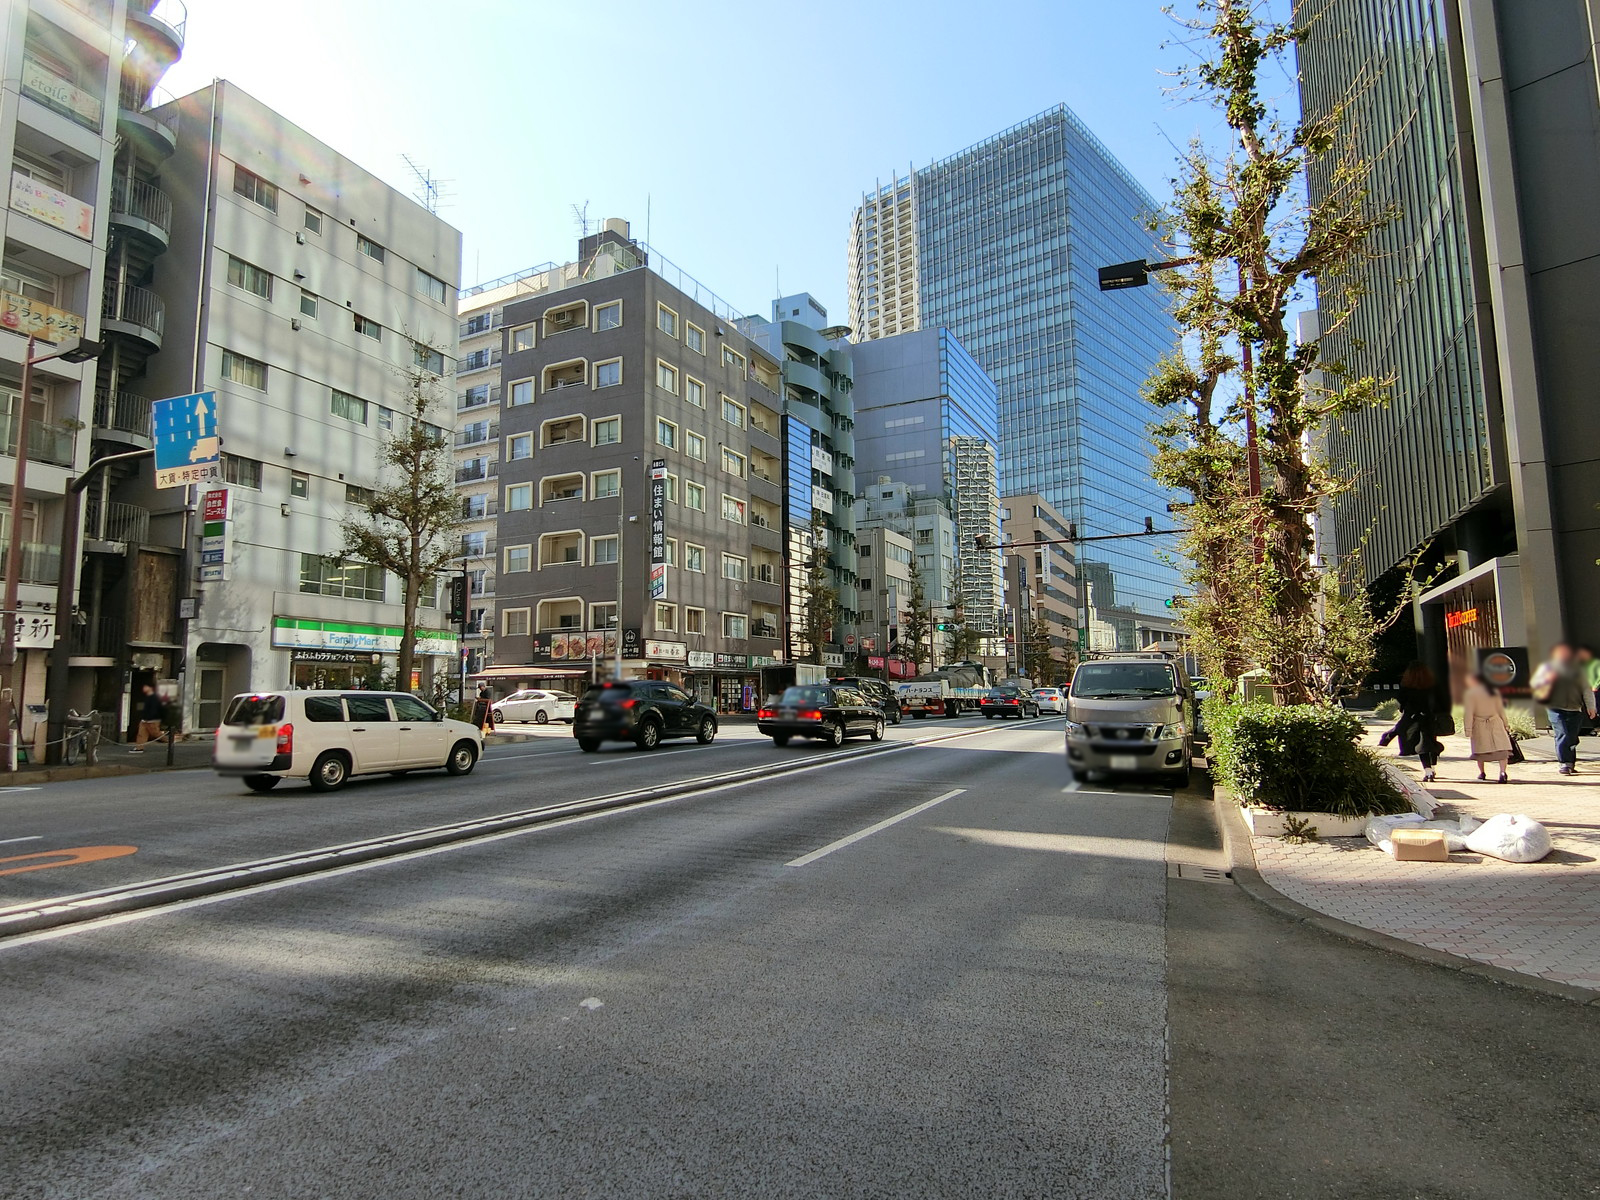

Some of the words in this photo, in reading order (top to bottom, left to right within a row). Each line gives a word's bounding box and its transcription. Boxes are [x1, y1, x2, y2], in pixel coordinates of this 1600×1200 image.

[30, 76, 68, 102] étoile
[8, 303, 80, 334] フラスタジオ
[652, 484, 664, 559] 住まい情報館
[329, 633, 380, 646] FamilyMart
